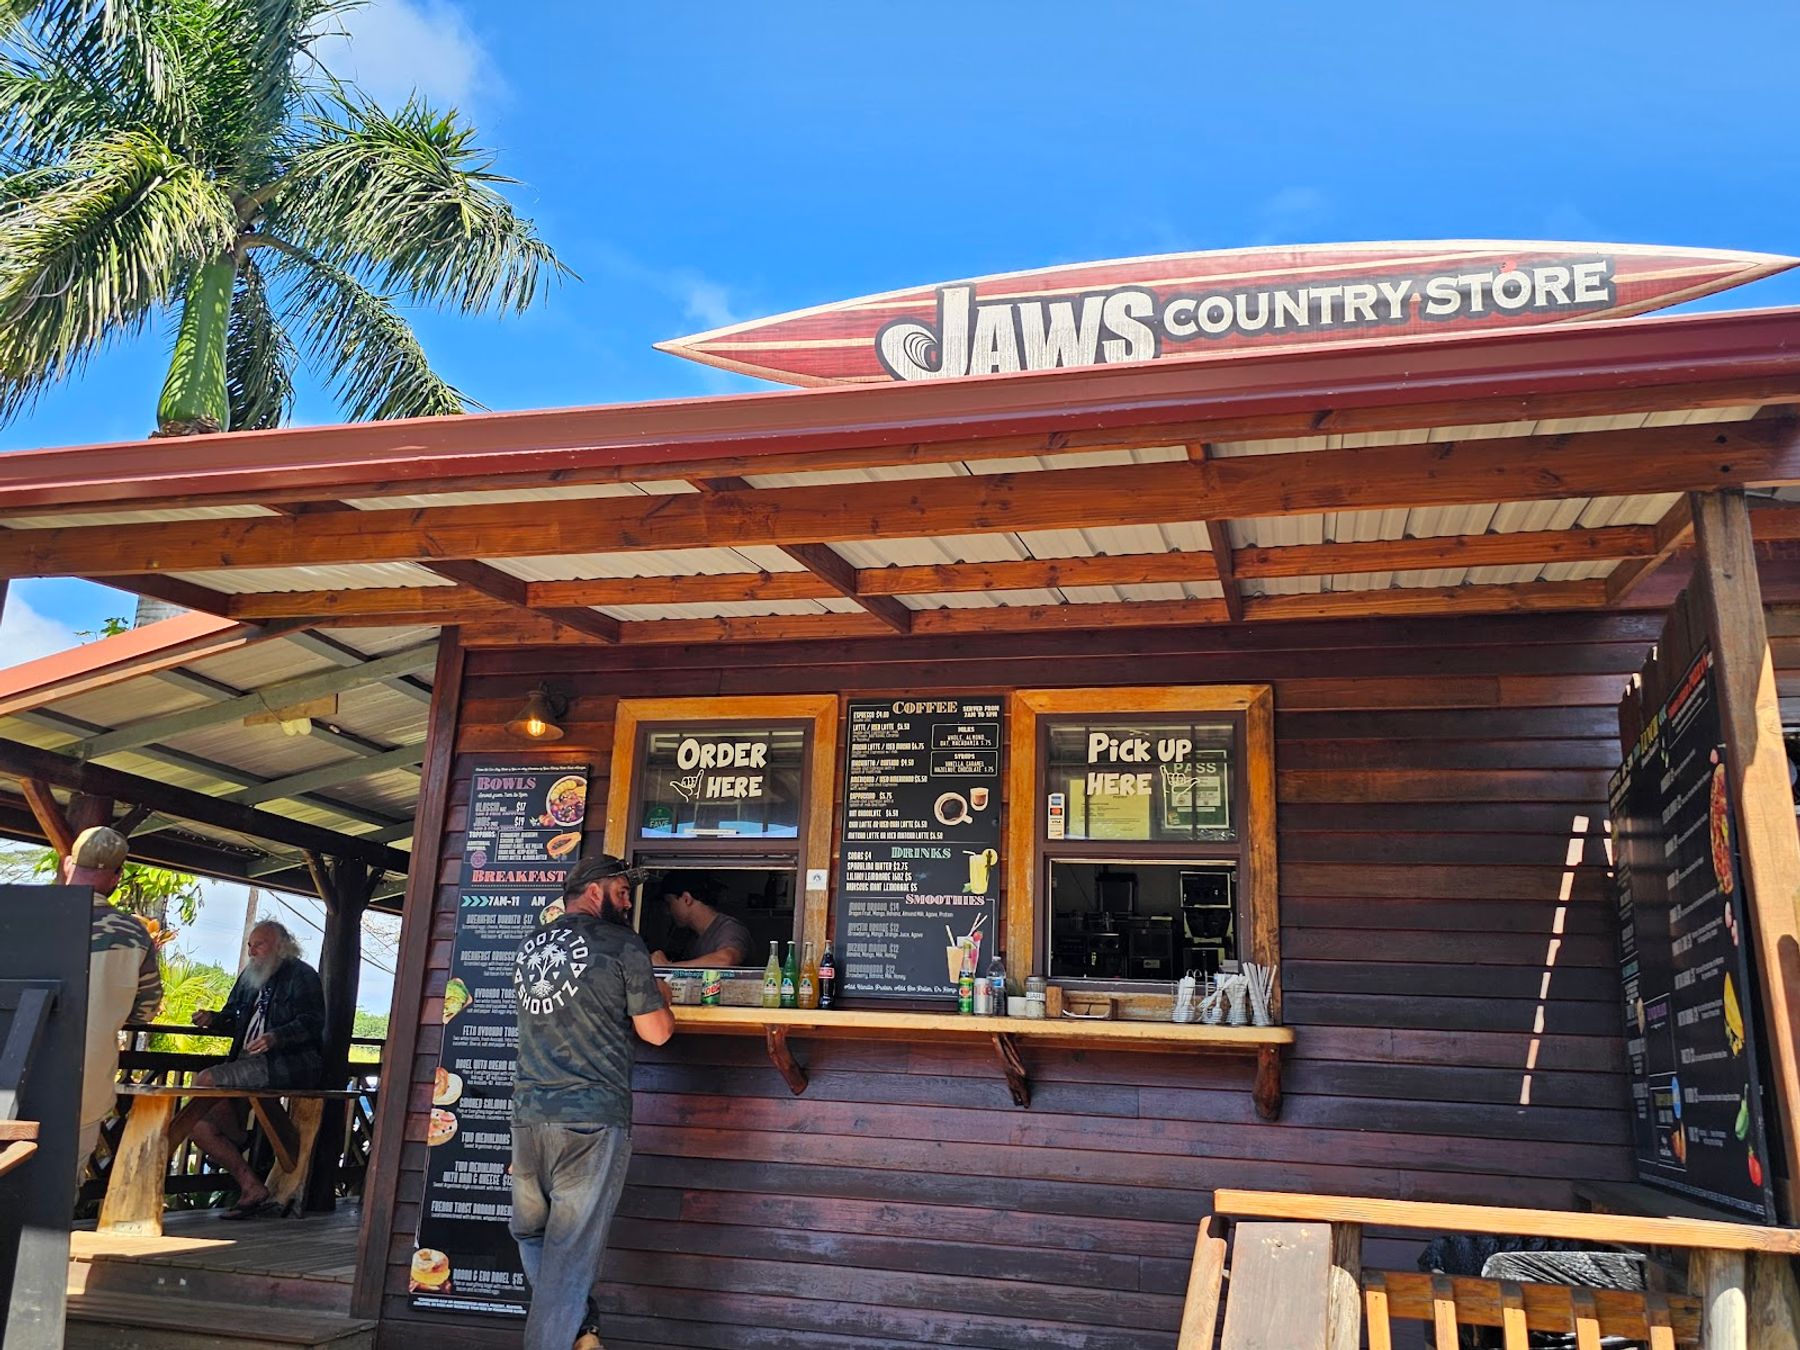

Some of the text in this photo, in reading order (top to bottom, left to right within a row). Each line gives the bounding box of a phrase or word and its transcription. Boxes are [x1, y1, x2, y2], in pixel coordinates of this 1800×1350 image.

[880, 260, 1608, 381] JAWS COUNTRY STORE
[892, 700, 958, 714] COFFEE
[853, 723, 866, 731] LATTE
[881, 723, 894, 731] LATTE
[868, 743, 880, 751] LATTE
[1157, 738, 1193, 762] UP
[677, 738, 768, 770] ORDER
[1174, 762, 1217, 773] PASS
[476, 776, 536, 790] BOWLS
[706, 776, 763, 798] HERE
[1086, 772, 1152, 796] HERE
[516, 801, 526, 812] $17
[866, 832, 880, 840] LATTE
[848, 851, 872, 860] SODAS $4
[891, 847, 951, 858] DRINKS
[847, 862, 892, 870] SPARKLING WATER
[472, 869, 567, 882] BREAKFAST
[865, 872, 890, 881] LEMONADE
[904, 872, 912, 882] $5
[846, 882, 918, 892] HIBISCUS MINT LEMONADE $5
[531, 896, 546, 906] AM
[905, 894, 986, 906] SMOOTHIES
[466, 914, 497, 924] BREAKFAST
[498, 914, 522, 924] BURRITO
[890, 922, 900, 932] $12
[889, 942, 900, 952] $12
[460, 950, 492, 961] BREAKFAST
[516, 929, 589, 1015] ROOTZ TO SHOOTZ
[463, 1025, 504, 1036] FETA AVOCADO
[460, 1098, 483, 1108] SMOKED
[483, 1098, 508, 1110] SALMON
[462, 1132, 475, 1142] TWO
[455, 1161, 468, 1172] TWO
[443, 1171, 459, 1183] WITH
[478, 1173, 500, 1186] CHEESE
[431, 1200, 454, 1213] FRENCH
[454, 1202, 473, 1214] TOAST
[479, 1270, 490, 1282] EGG
[491, 1271, 510, 1284] BAGEL
[512, 1272, 524, 1286] $15
